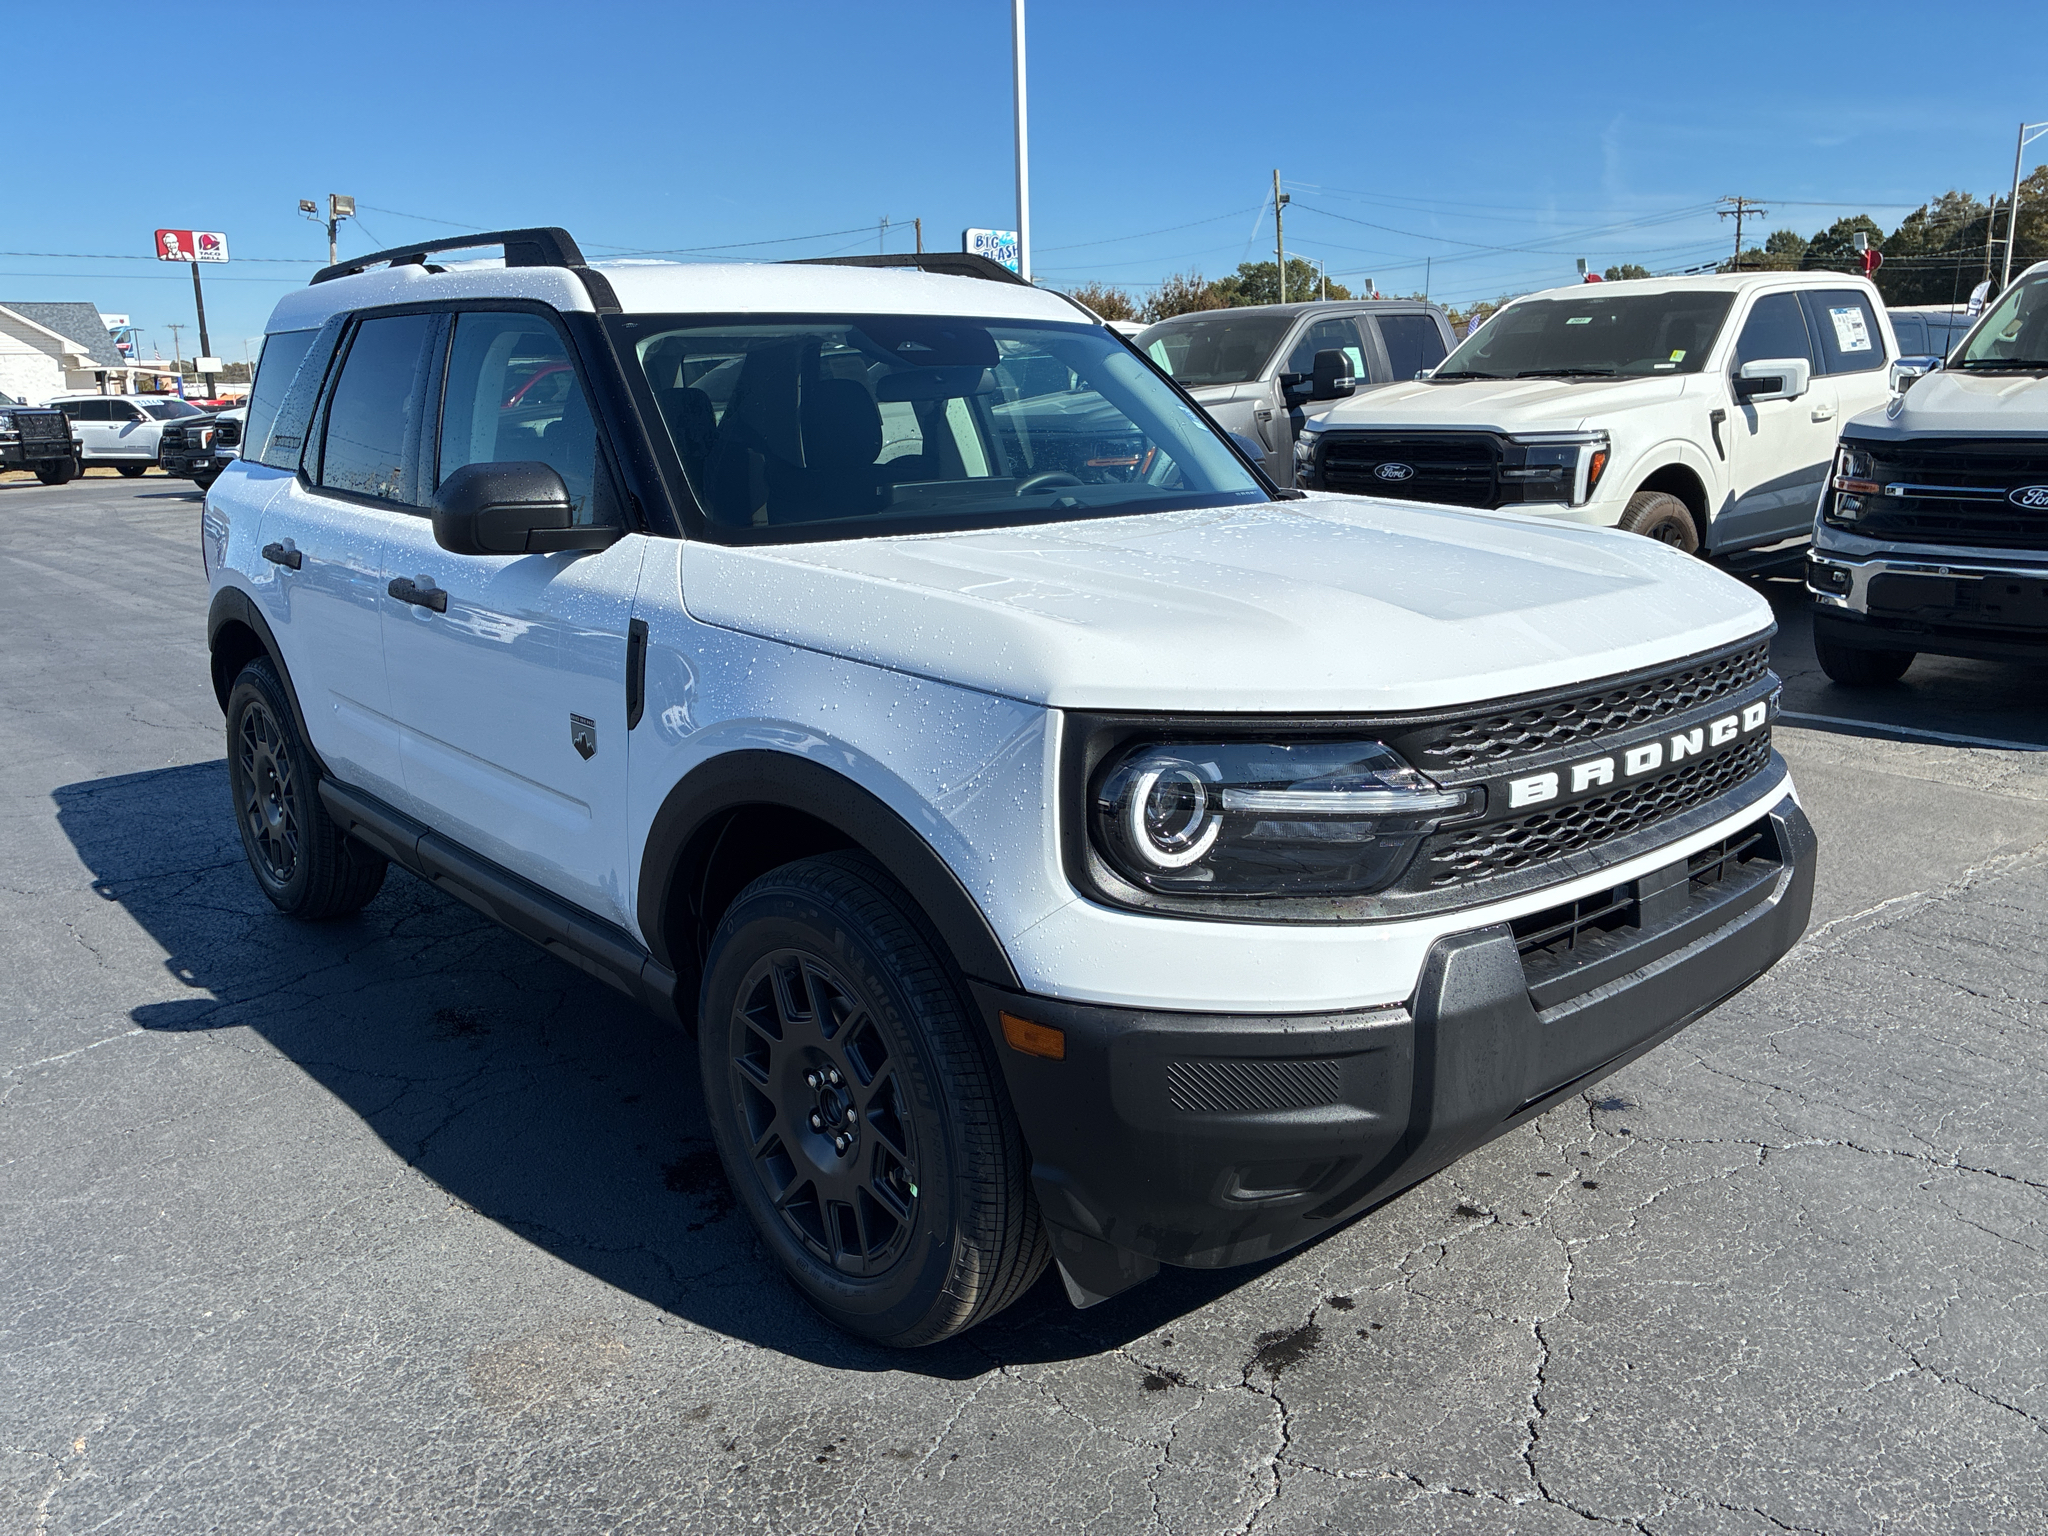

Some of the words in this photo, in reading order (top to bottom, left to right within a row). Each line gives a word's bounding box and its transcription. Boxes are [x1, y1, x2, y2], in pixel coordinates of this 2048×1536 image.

[976, 235, 999, 249] BIG
[983, 246, 1018, 261] PLASH
[1380, 465, 1408, 479] Ford
[1508, 701, 1767, 809] BRONCO
[865, 975, 931, 1106] MICHELIN
